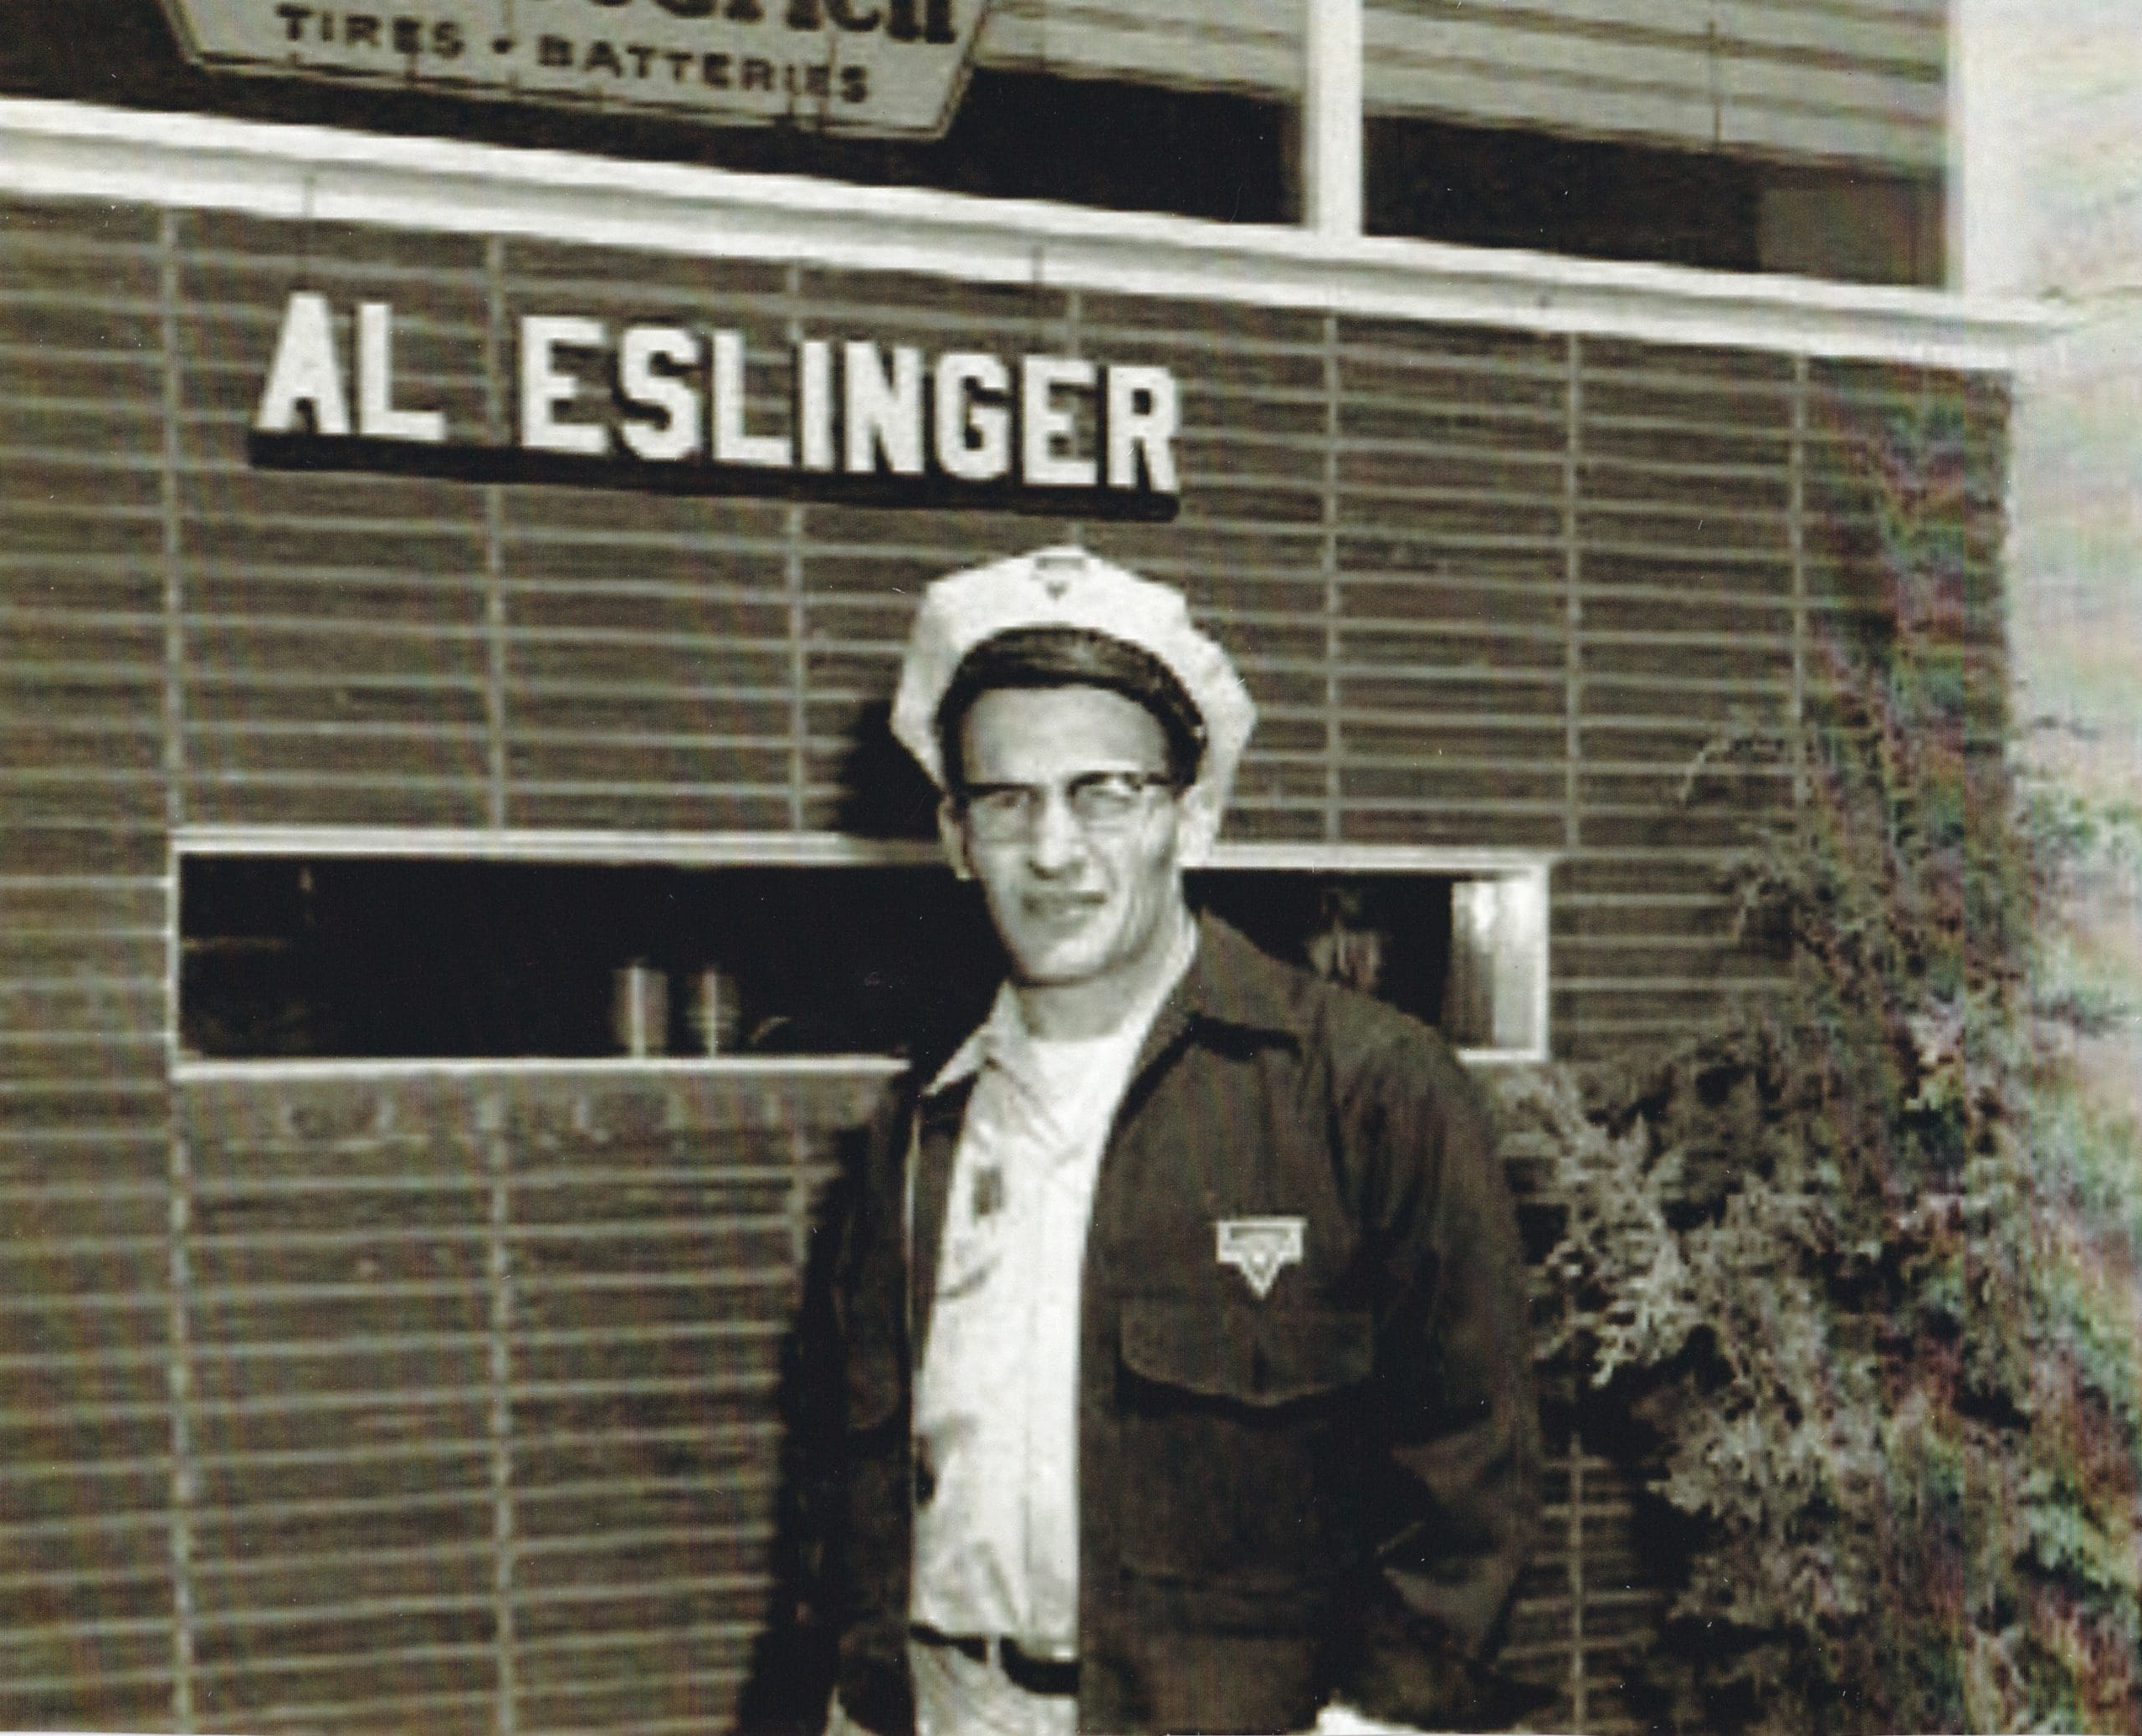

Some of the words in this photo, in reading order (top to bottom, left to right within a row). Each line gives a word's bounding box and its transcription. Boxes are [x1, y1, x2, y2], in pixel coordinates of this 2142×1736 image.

[276, 3, 465, 58] TIRES
[538, 35, 869, 102] BATTERIES
[259, 291, 448, 442] AL
[520, 315, 1180, 494] ESLINGER
